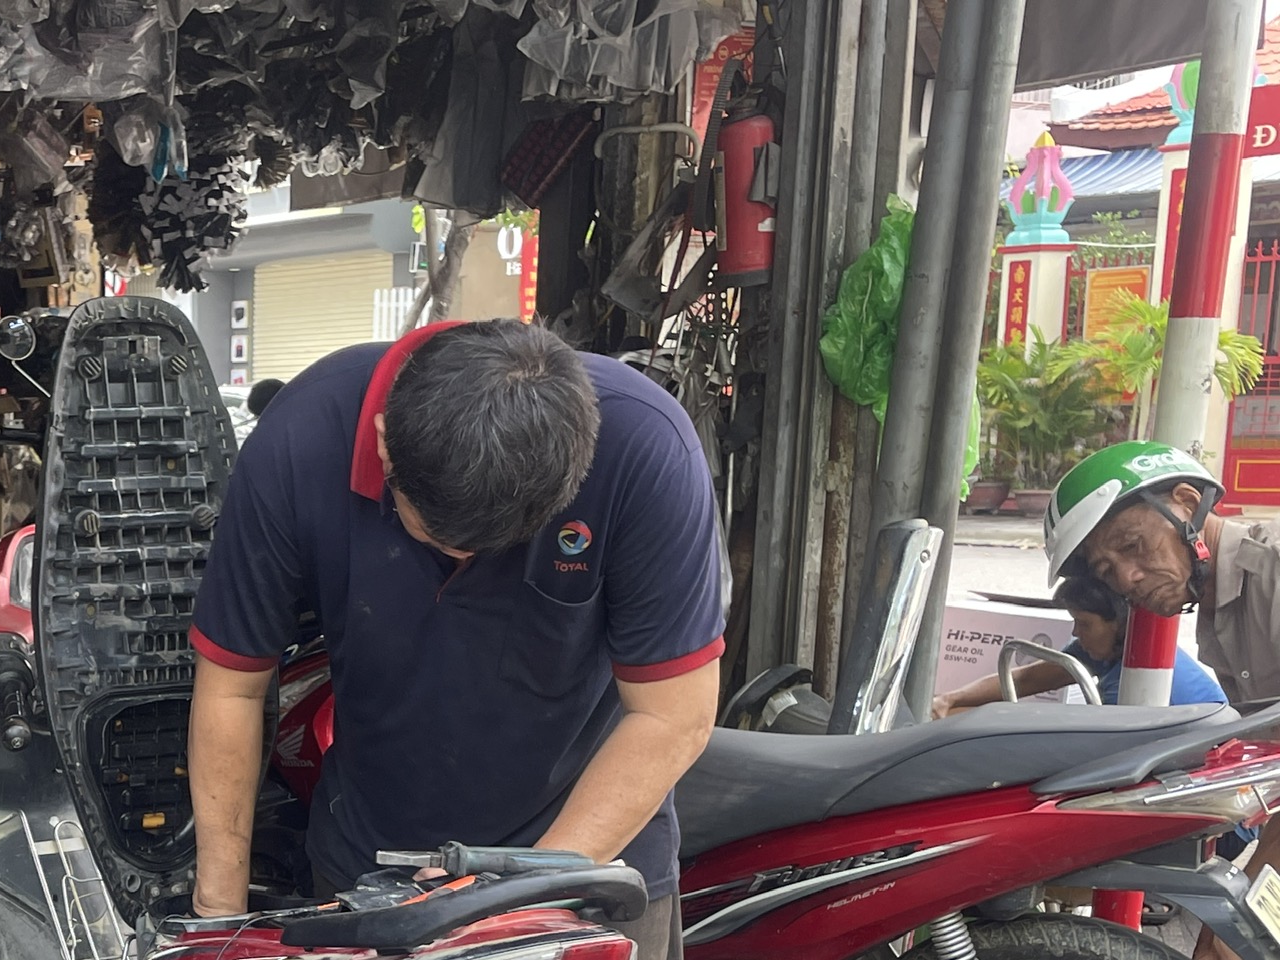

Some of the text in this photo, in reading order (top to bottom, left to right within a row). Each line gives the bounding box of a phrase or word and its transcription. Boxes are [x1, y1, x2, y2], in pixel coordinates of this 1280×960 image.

[553, 560, 589, 572] TOTAL
[945, 644, 984, 657] GEAR OIL
[280, 759, 315, 767] HONDA
[826, 881, 897, 911] HELMET-IN
